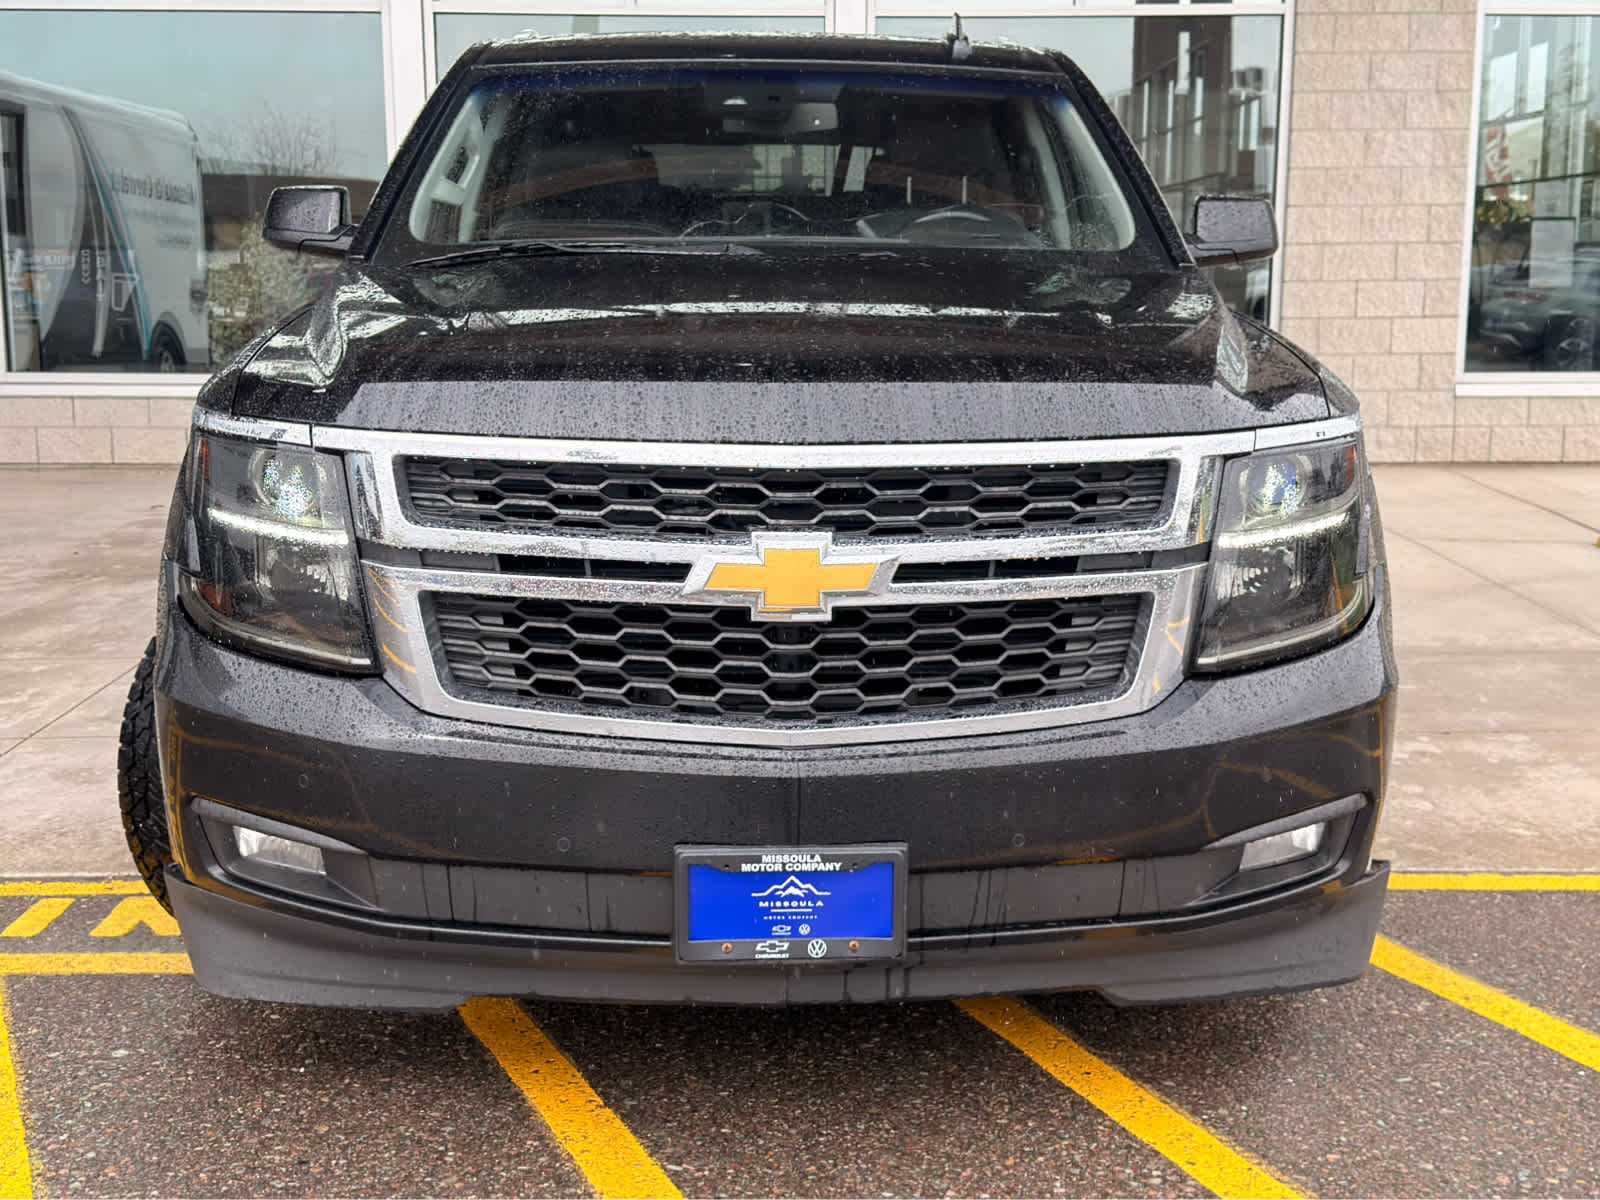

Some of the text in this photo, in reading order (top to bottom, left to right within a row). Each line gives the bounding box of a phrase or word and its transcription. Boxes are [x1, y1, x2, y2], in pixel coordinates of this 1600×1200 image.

[761, 854, 822, 863] MISSOULA
[741, 862, 842, 872] MOTOR COMPANY
